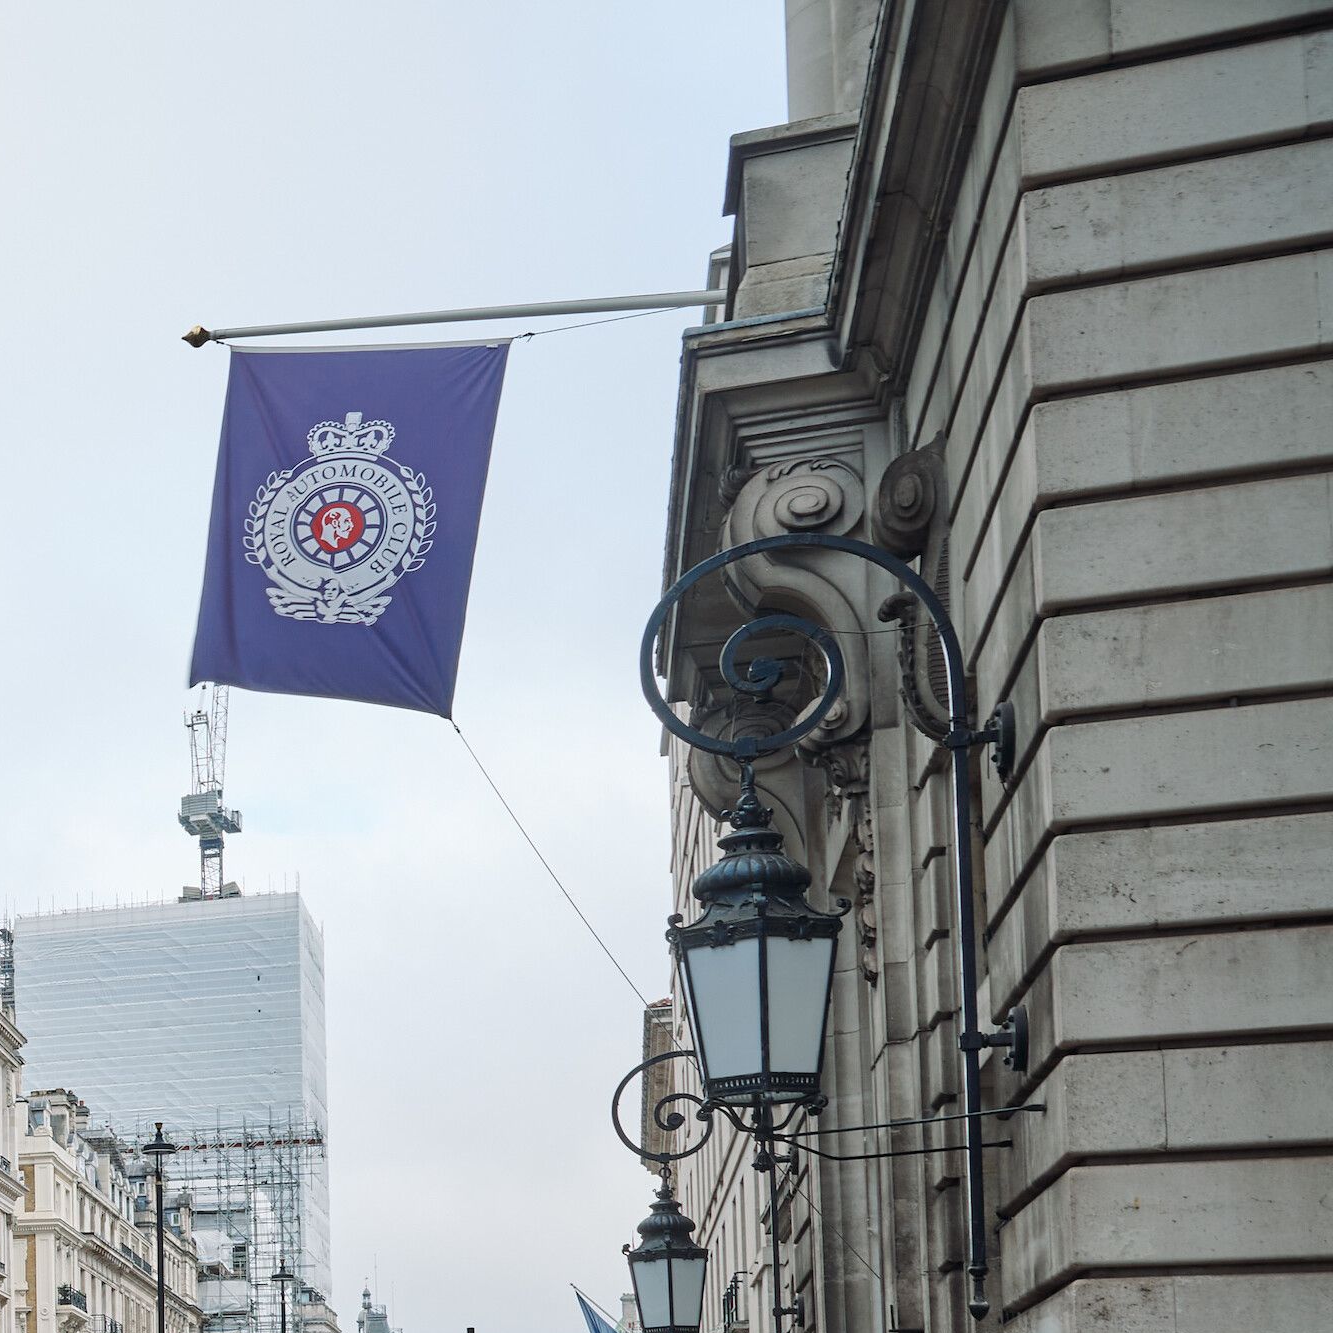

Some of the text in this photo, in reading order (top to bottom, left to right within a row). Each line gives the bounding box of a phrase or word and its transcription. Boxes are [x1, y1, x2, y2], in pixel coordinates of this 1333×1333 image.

[270, 464, 408, 574] ROYAL AUTOMOBILE CLUB
